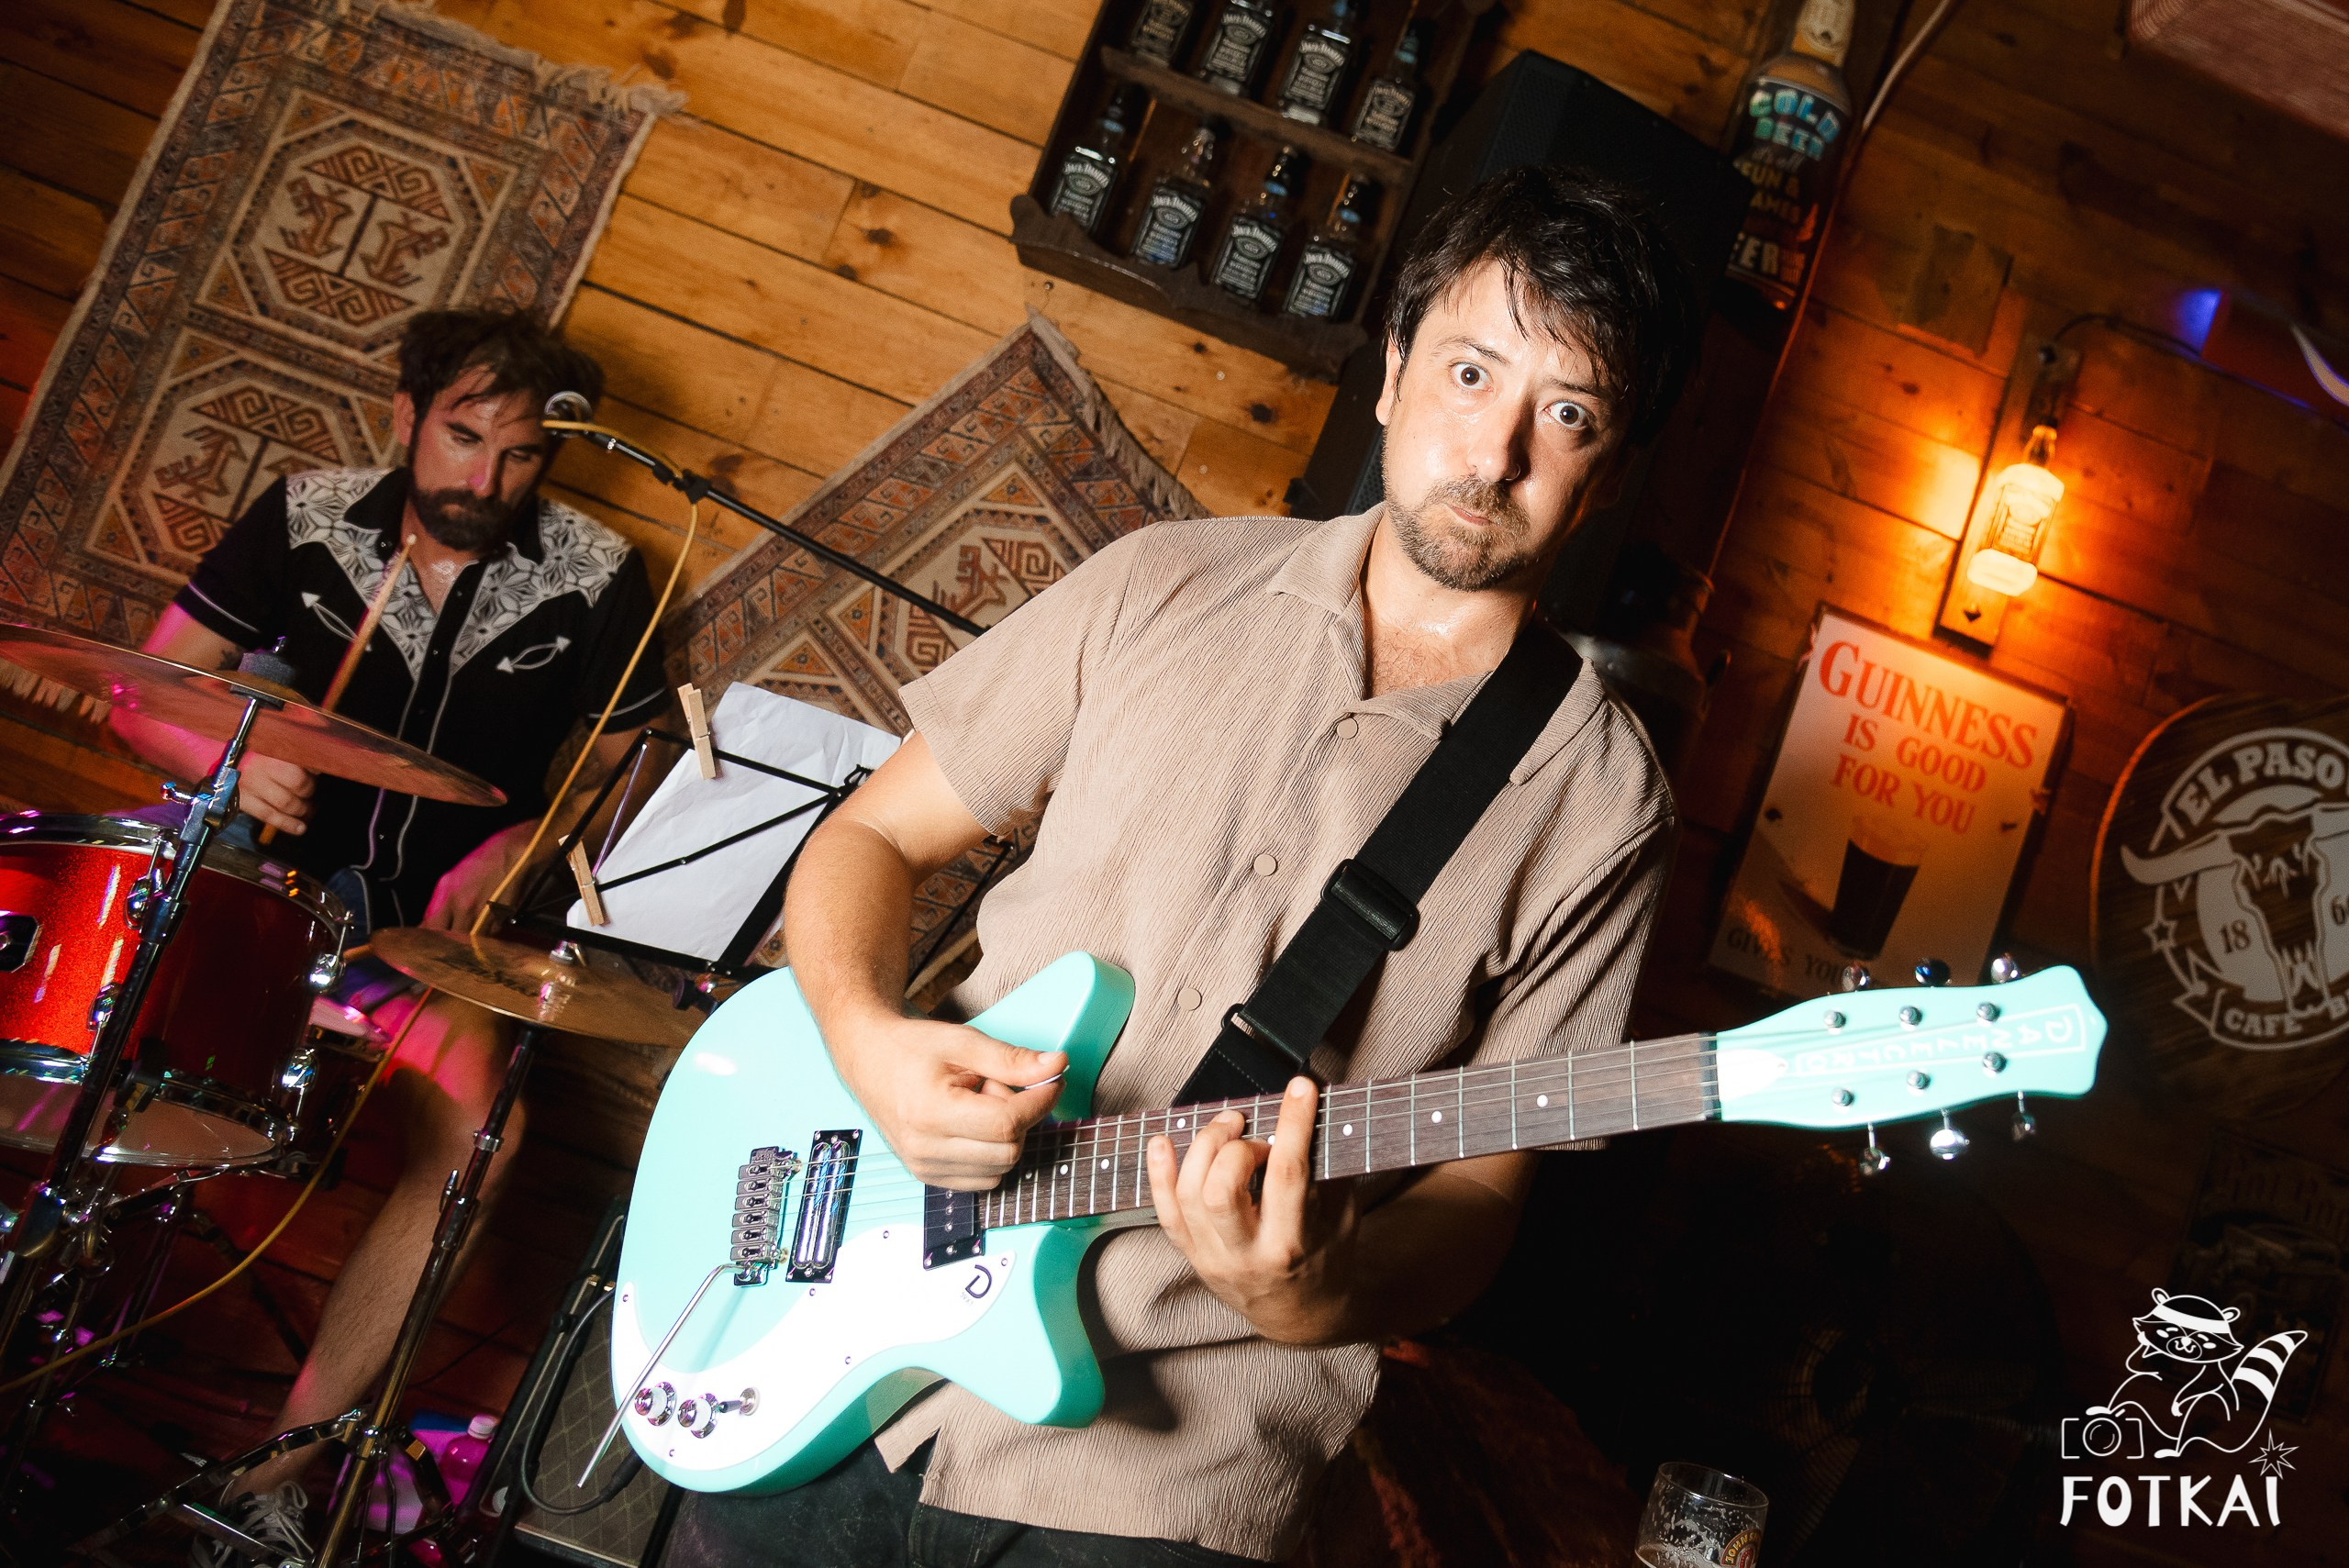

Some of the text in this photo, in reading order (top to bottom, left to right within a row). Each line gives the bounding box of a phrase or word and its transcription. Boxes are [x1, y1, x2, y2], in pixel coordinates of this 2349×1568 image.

[1749, 89, 1841, 144] COLD
[1753, 117, 1824, 162] BEER
[1819, 639, 2038, 770] GUINNESS
[1842, 713, 1987, 794] IS GOOD
[1831, 753, 1976, 836] FOR YOU
[2176, 764, 2232, 826] EL
[2220, 918, 2251, 954] 18
[1804, 1016, 2073, 1073] DANELECTRO
[1724, 1533, 1749, 1564] JOHN
